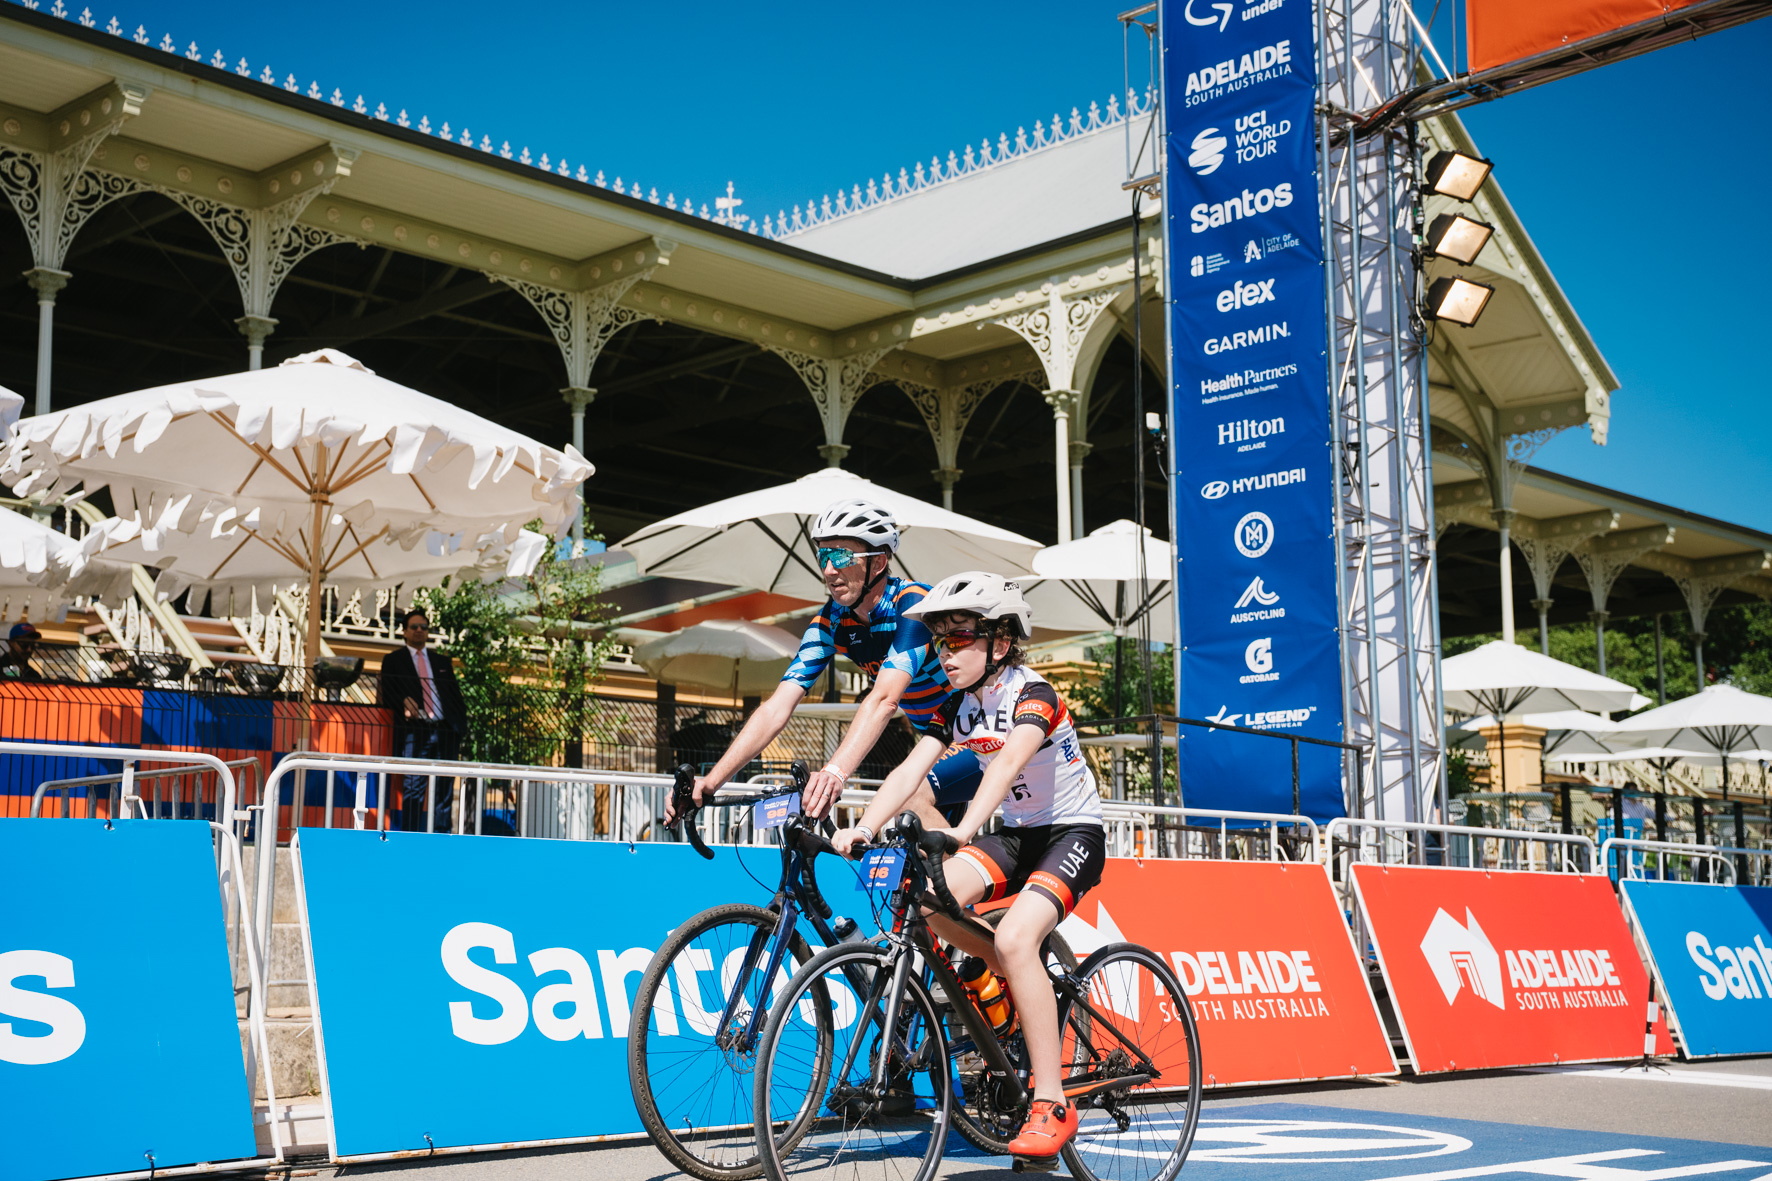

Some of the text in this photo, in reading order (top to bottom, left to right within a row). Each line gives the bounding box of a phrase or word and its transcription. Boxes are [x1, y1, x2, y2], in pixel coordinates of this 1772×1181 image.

[1242, 0, 1286, 21] under
[1185, 40, 1292, 96] ADELAIDE
[1185, 64, 1292, 108] SOUTH AUSTRALIA
[1235, 110, 1267, 132] UCI
[1236, 120, 1291, 148] WORLD
[1236, 140, 1277, 164] TOUR
[1190, 182, 1294, 233] Santos
[1266, 233, 1292, 246] CITY OF
[1267, 239, 1300, 253] ADELAIDE
[1216, 278, 1276, 312] efex
[1218, 417, 1285, 445] Hilton
[1237, 441, 1267, 453] ADELAIDE
[1232, 468, 1307, 494] HYUNDAI
[1230, 608, 1285, 624] AUSCYCLING
[1239, 672, 1280, 684] GATORADE
[955, 708, 1007, 737] UAE
[965, 739, 1006, 752] mirate
[1060, 737, 1076, 762] FAB
[1059, 841, 1090, 879] UAE
[1504, 949, 1621, 989] ADELAIDE
[440, 921, 857, 1045] Santos
[1233, 997, 1331, 1020] AUSTRALIA
[1515, 989, 1629, 1011] SOUTH AUSTRALIA
